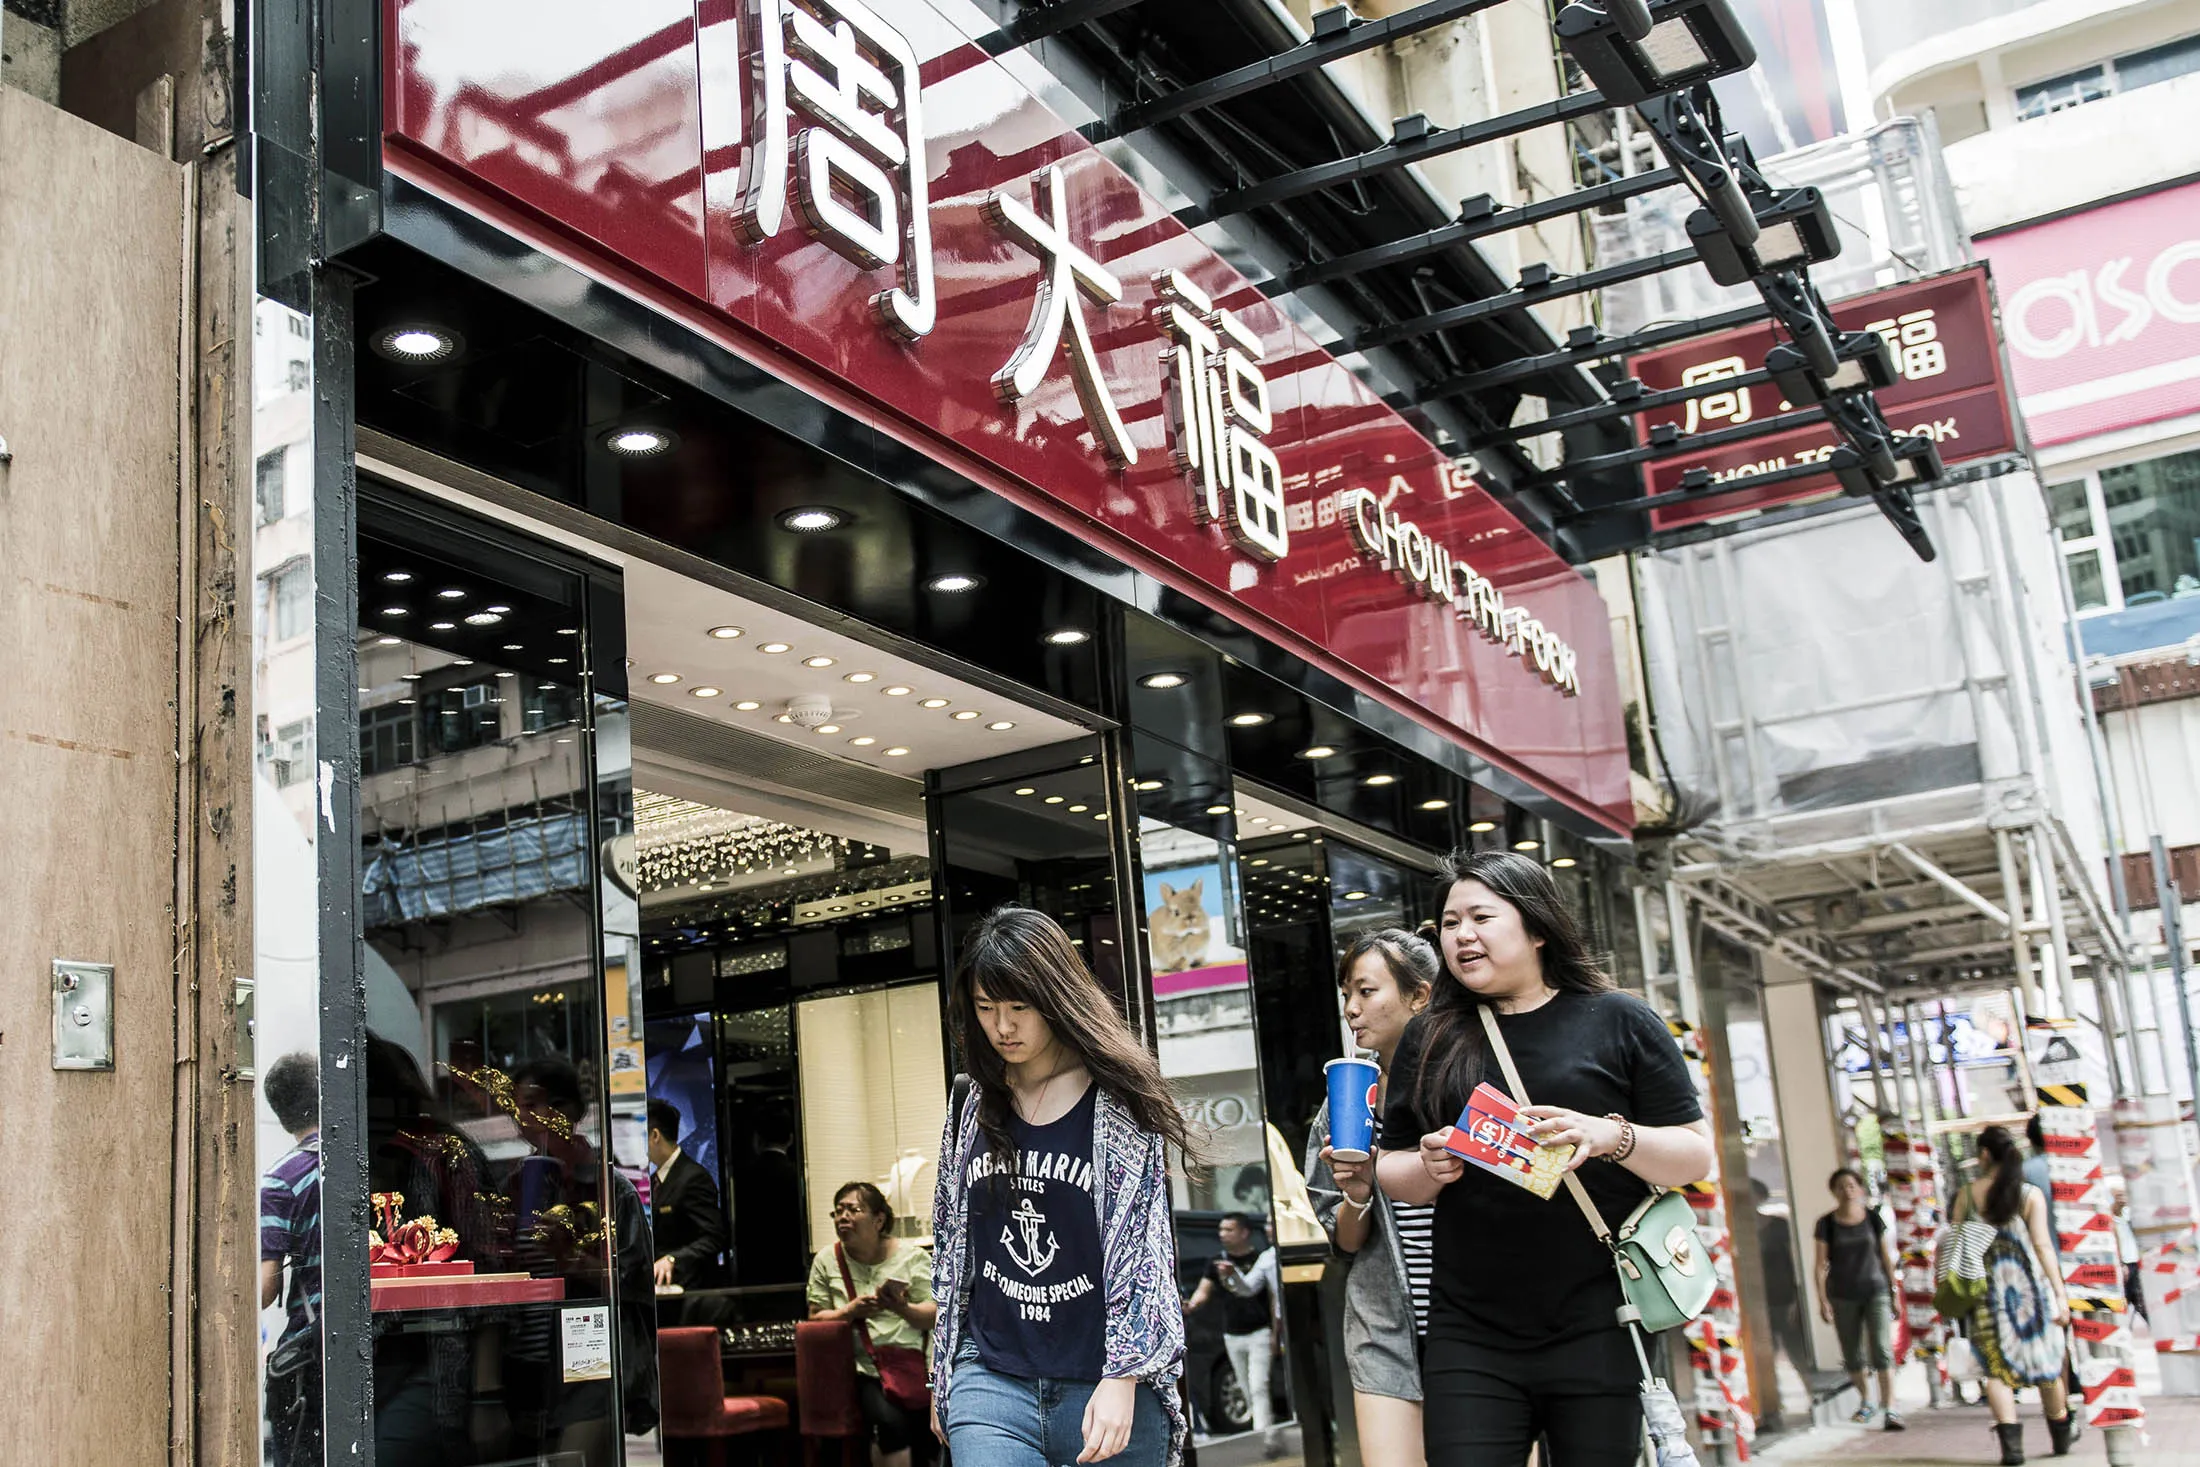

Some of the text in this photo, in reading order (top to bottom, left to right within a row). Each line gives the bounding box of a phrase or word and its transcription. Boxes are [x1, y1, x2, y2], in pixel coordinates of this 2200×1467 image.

[732, 0, 1289, 562] 周大福
[1682, 308, 1947, 434] 周福
[1346, 487, 1454, 603] CHOW
[1456, 560, 1508, 642] TAI
[1508, 606, 1582, 696] FOOK
[1475, 1121, 1500, 1145] UA
[1010, 1177, 1046, 1194] STYLES
[982, 1260, 1095, 1304] BE SOMEONE SPECIAL
[1019, 1303, 1051, 1323] 1984
